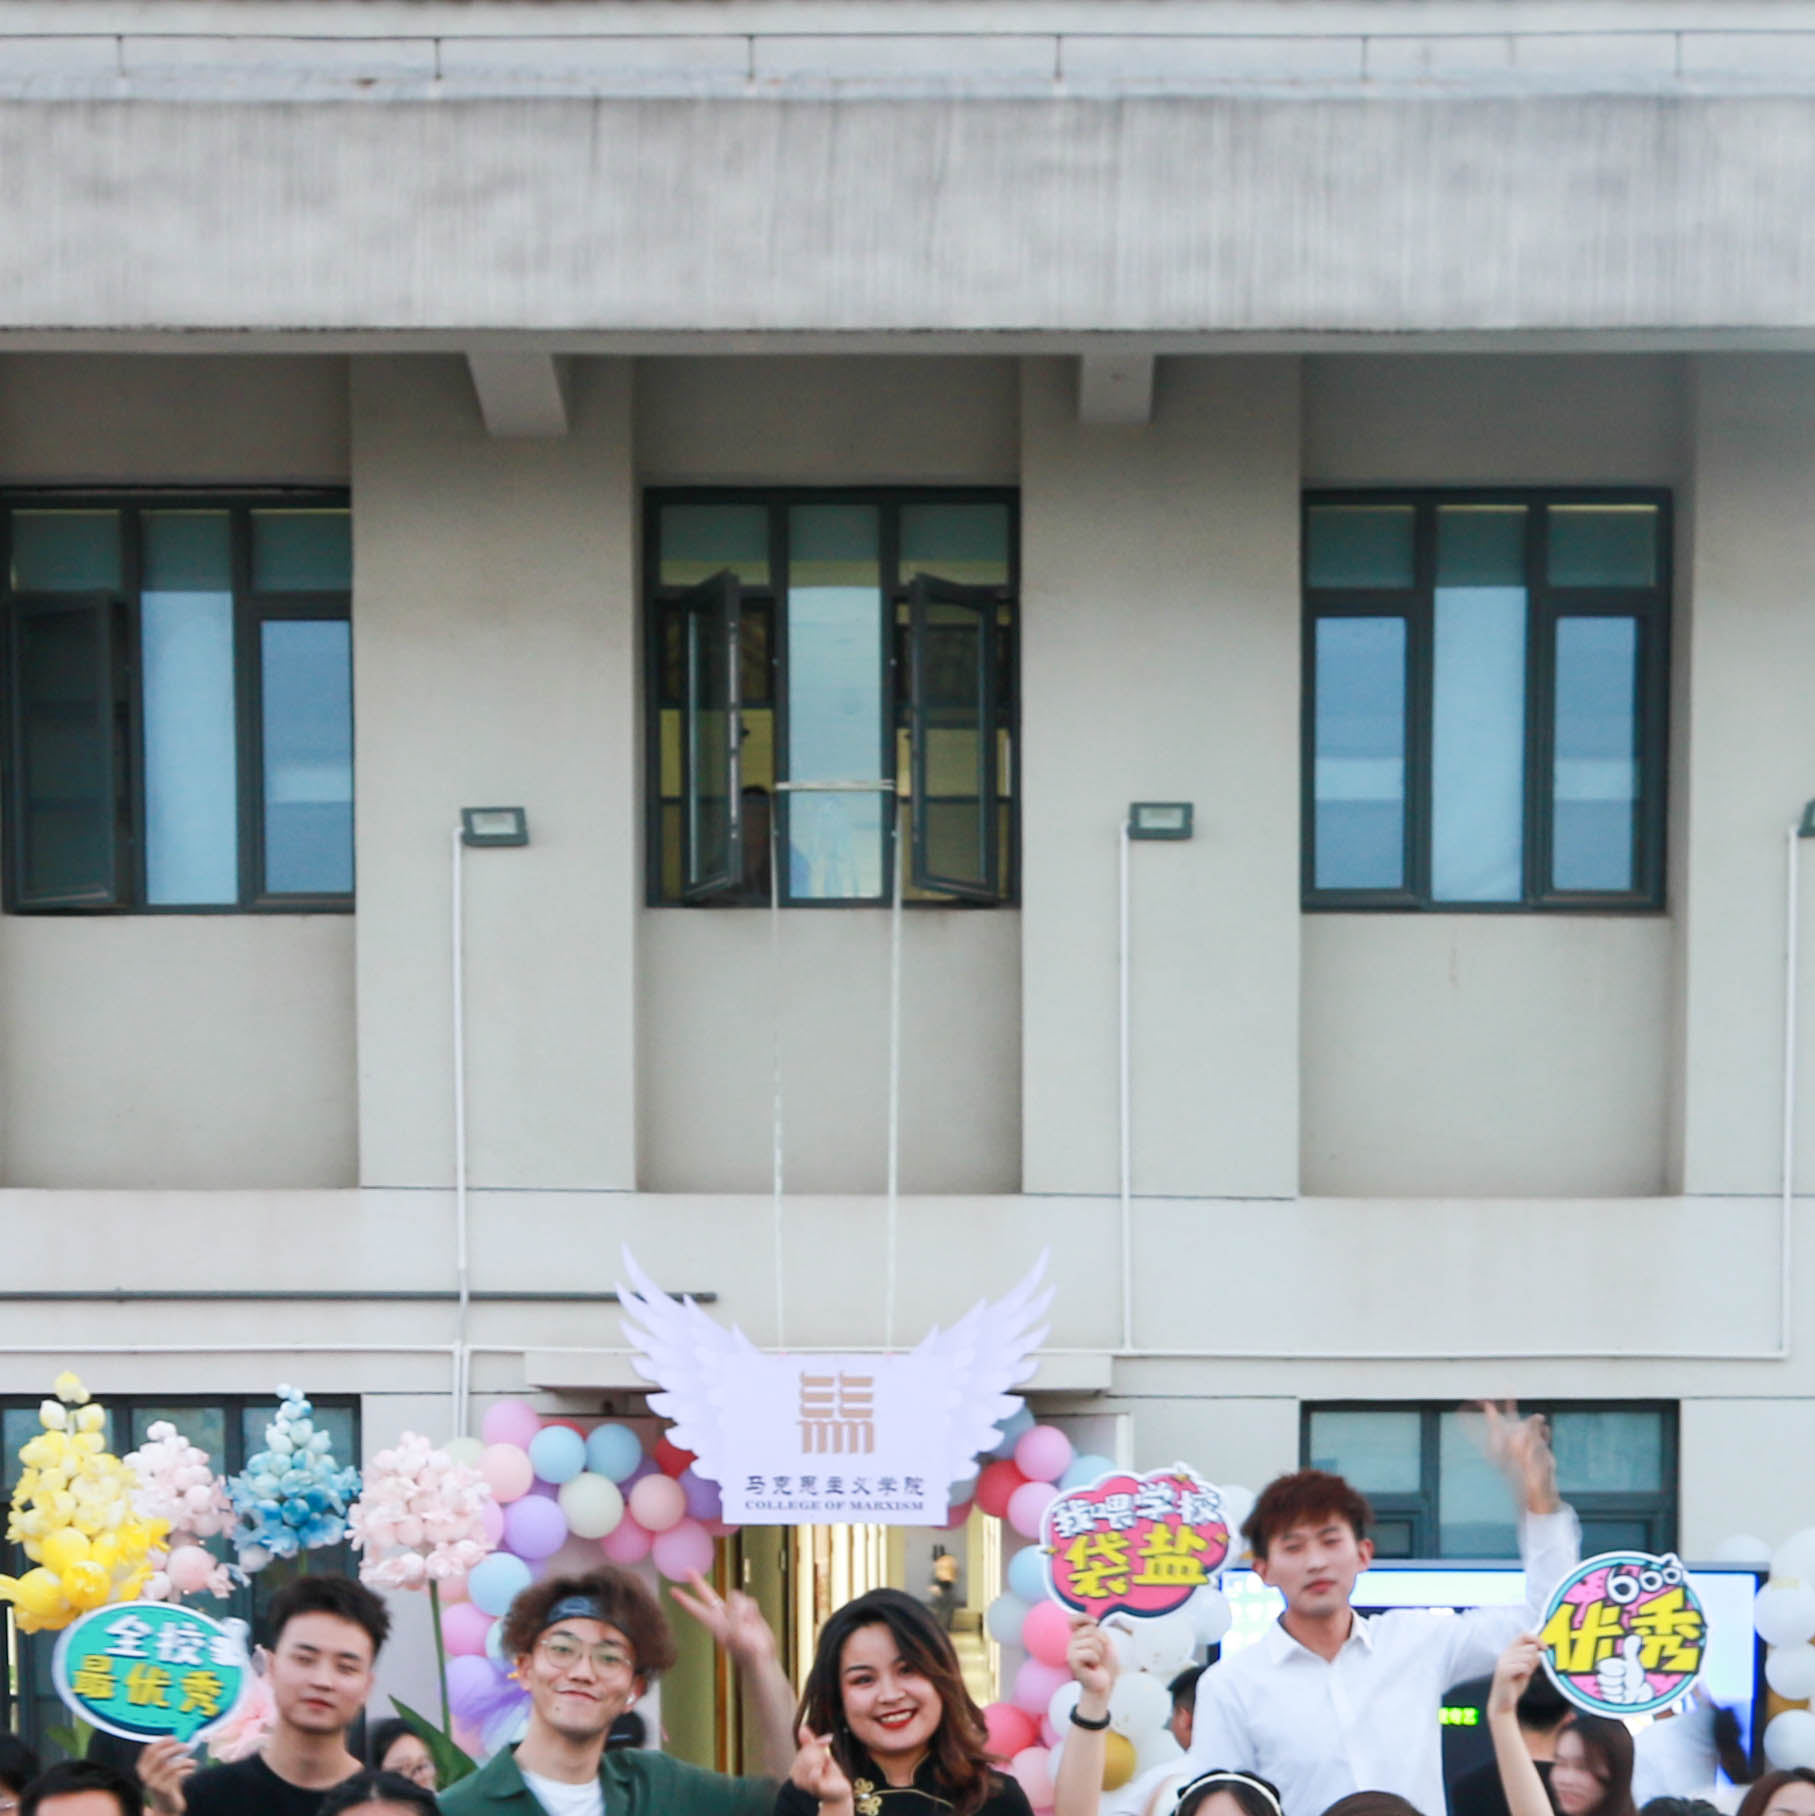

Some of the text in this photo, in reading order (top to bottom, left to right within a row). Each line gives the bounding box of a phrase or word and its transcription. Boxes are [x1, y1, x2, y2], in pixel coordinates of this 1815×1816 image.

[744, 1474, 925, 1497] 马克思主义学院
[744, 1500, 924, 1512] COLLEGE OF MARXISM
[1064, 1523, 1210, 1599] 袋盐
[104, 1614, 208, 1667] 全校
[1539, 1586, 1703, 1673] 优秀
[72, 1653, 226, 1718] 最优秀
